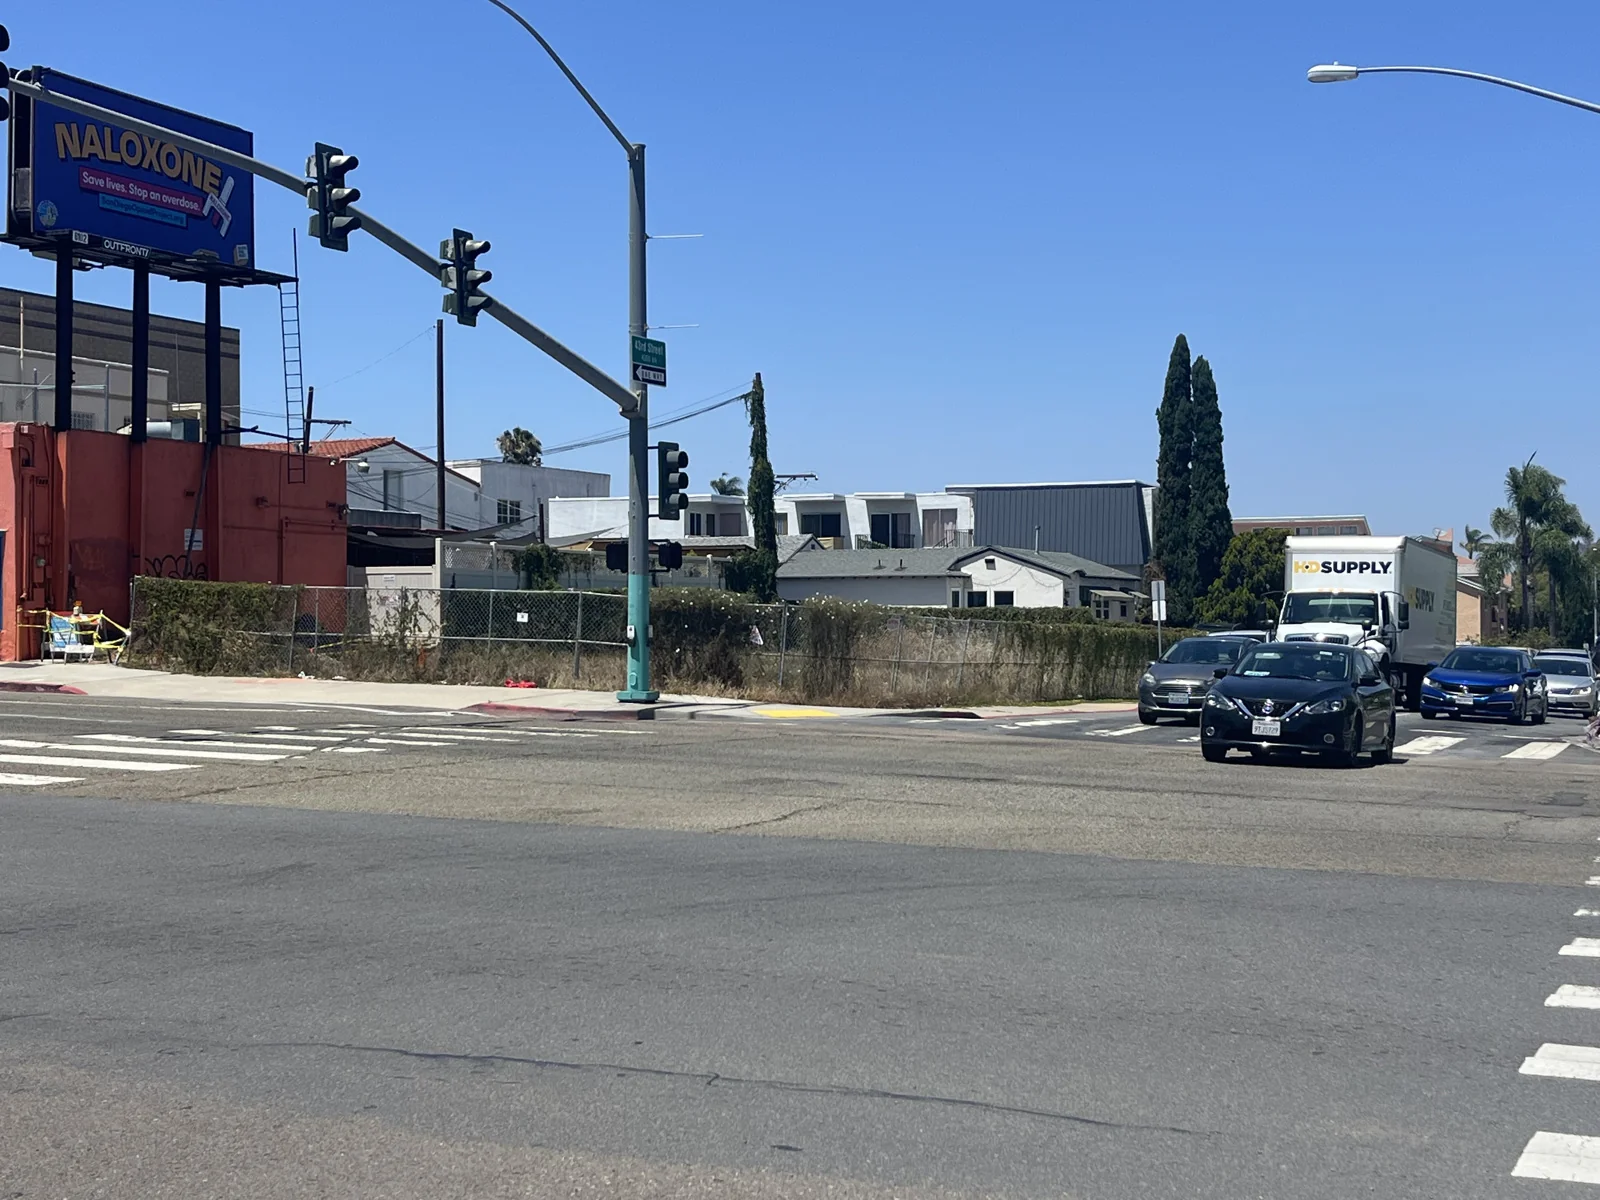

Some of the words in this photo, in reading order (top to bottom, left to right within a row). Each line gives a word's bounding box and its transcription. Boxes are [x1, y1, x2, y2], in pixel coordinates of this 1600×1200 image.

[55, 123, 222, 196] NALOXONE
[82, 171, 105, 187] Save
[106, 177, 127, 193] lives.
[129, 183, 148, 199] Stop
[149, 191, 161, 200] an
[162, 194, 200, 211] overdose.
